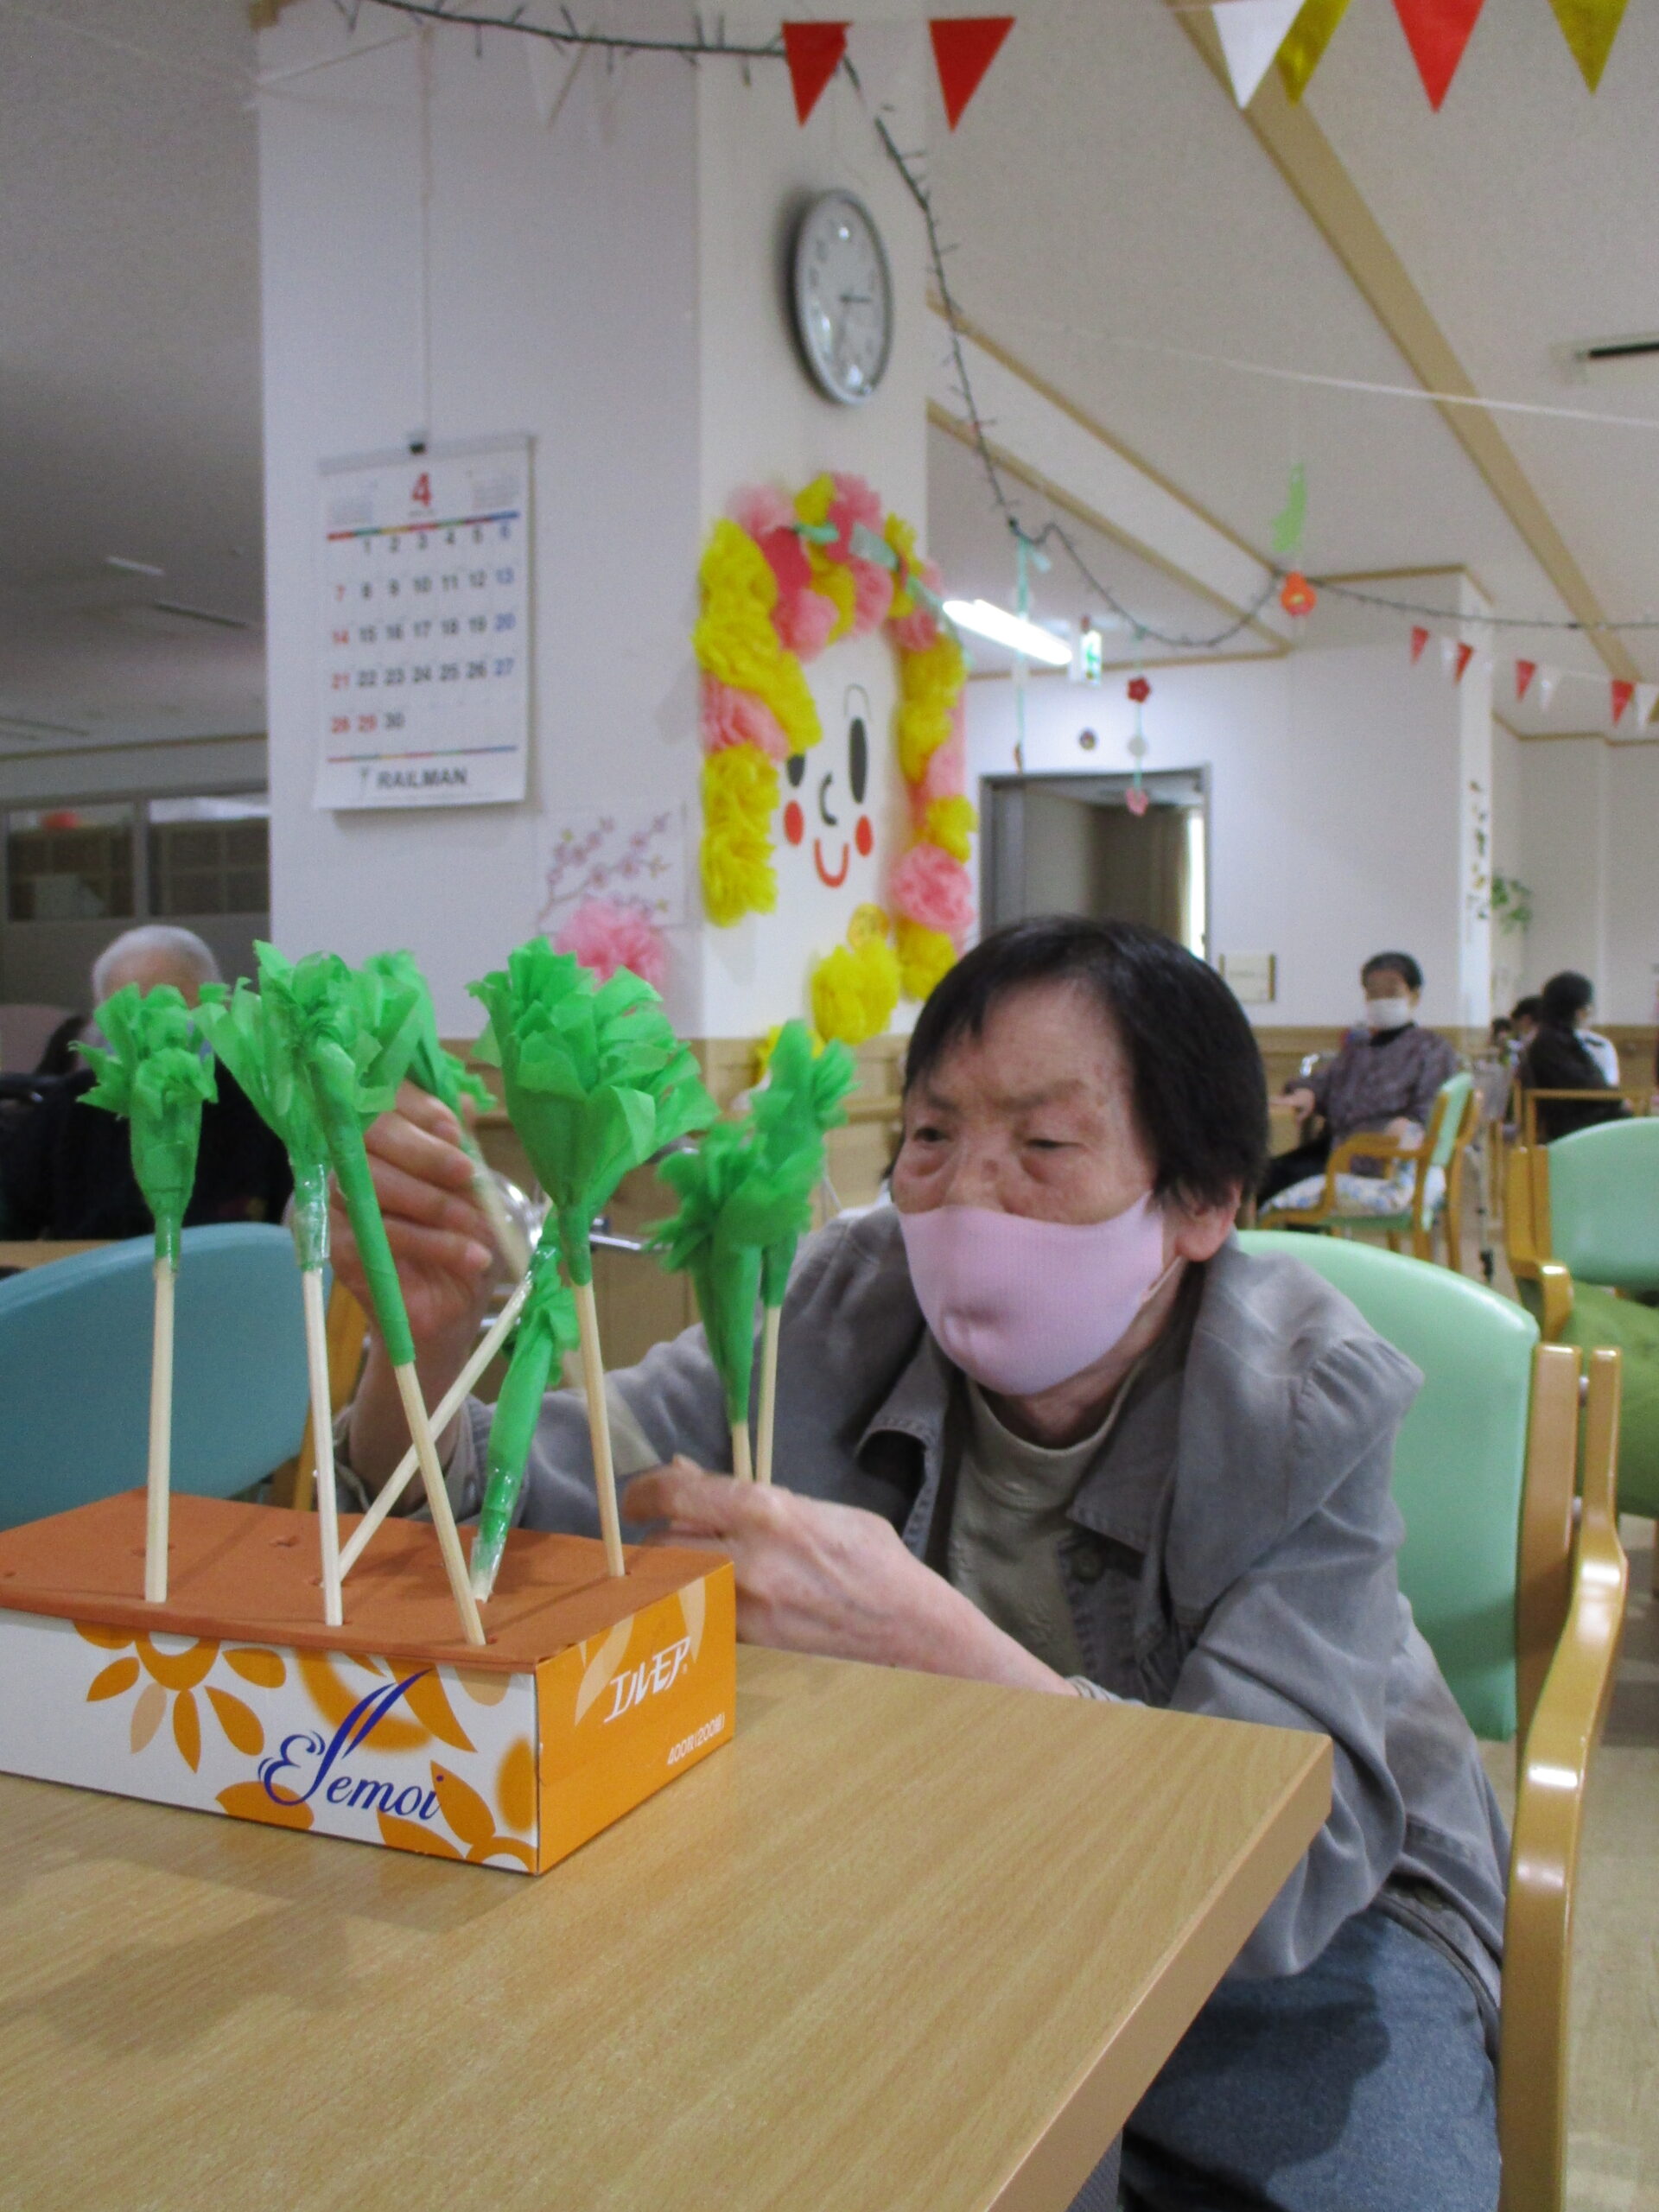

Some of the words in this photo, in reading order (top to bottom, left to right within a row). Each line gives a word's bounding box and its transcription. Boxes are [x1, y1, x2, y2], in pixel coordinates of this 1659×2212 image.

[411, 472, 432, 507] 4
[391, 533, 401, 553] 2
[418, 531, 429, 550] 3
[413, 575, 432, 594] 10
[442, 574, 459, 592] 11
[469, 569, 487, 588] 12
[332, 629, 350, 645] 14
[359, 625, 377, 643] 15
[386, 623, 404, 640] 16
[413, 620, 432, 638] 17
[441, 618, 459, 635] 18
[468, 614, 487, 632] 19
[332, 672, 350, 690] 21
[358, 669, 378, 688] 22
[385, 667, 405, 686] 23
[412, 665, 432, 683] 24
[439, 663, 460, 682] 25
[467, 660, 487, 679] 26
[494, 658, 515, 677] 27
[331, 715, 351, 734] 28
[358, 714, 378, 733] 29
[385, 711, 405, 729] 30
[377, 766, 468, 790] RAILMAN
[603, 1636, 690, 1724] エルモア
